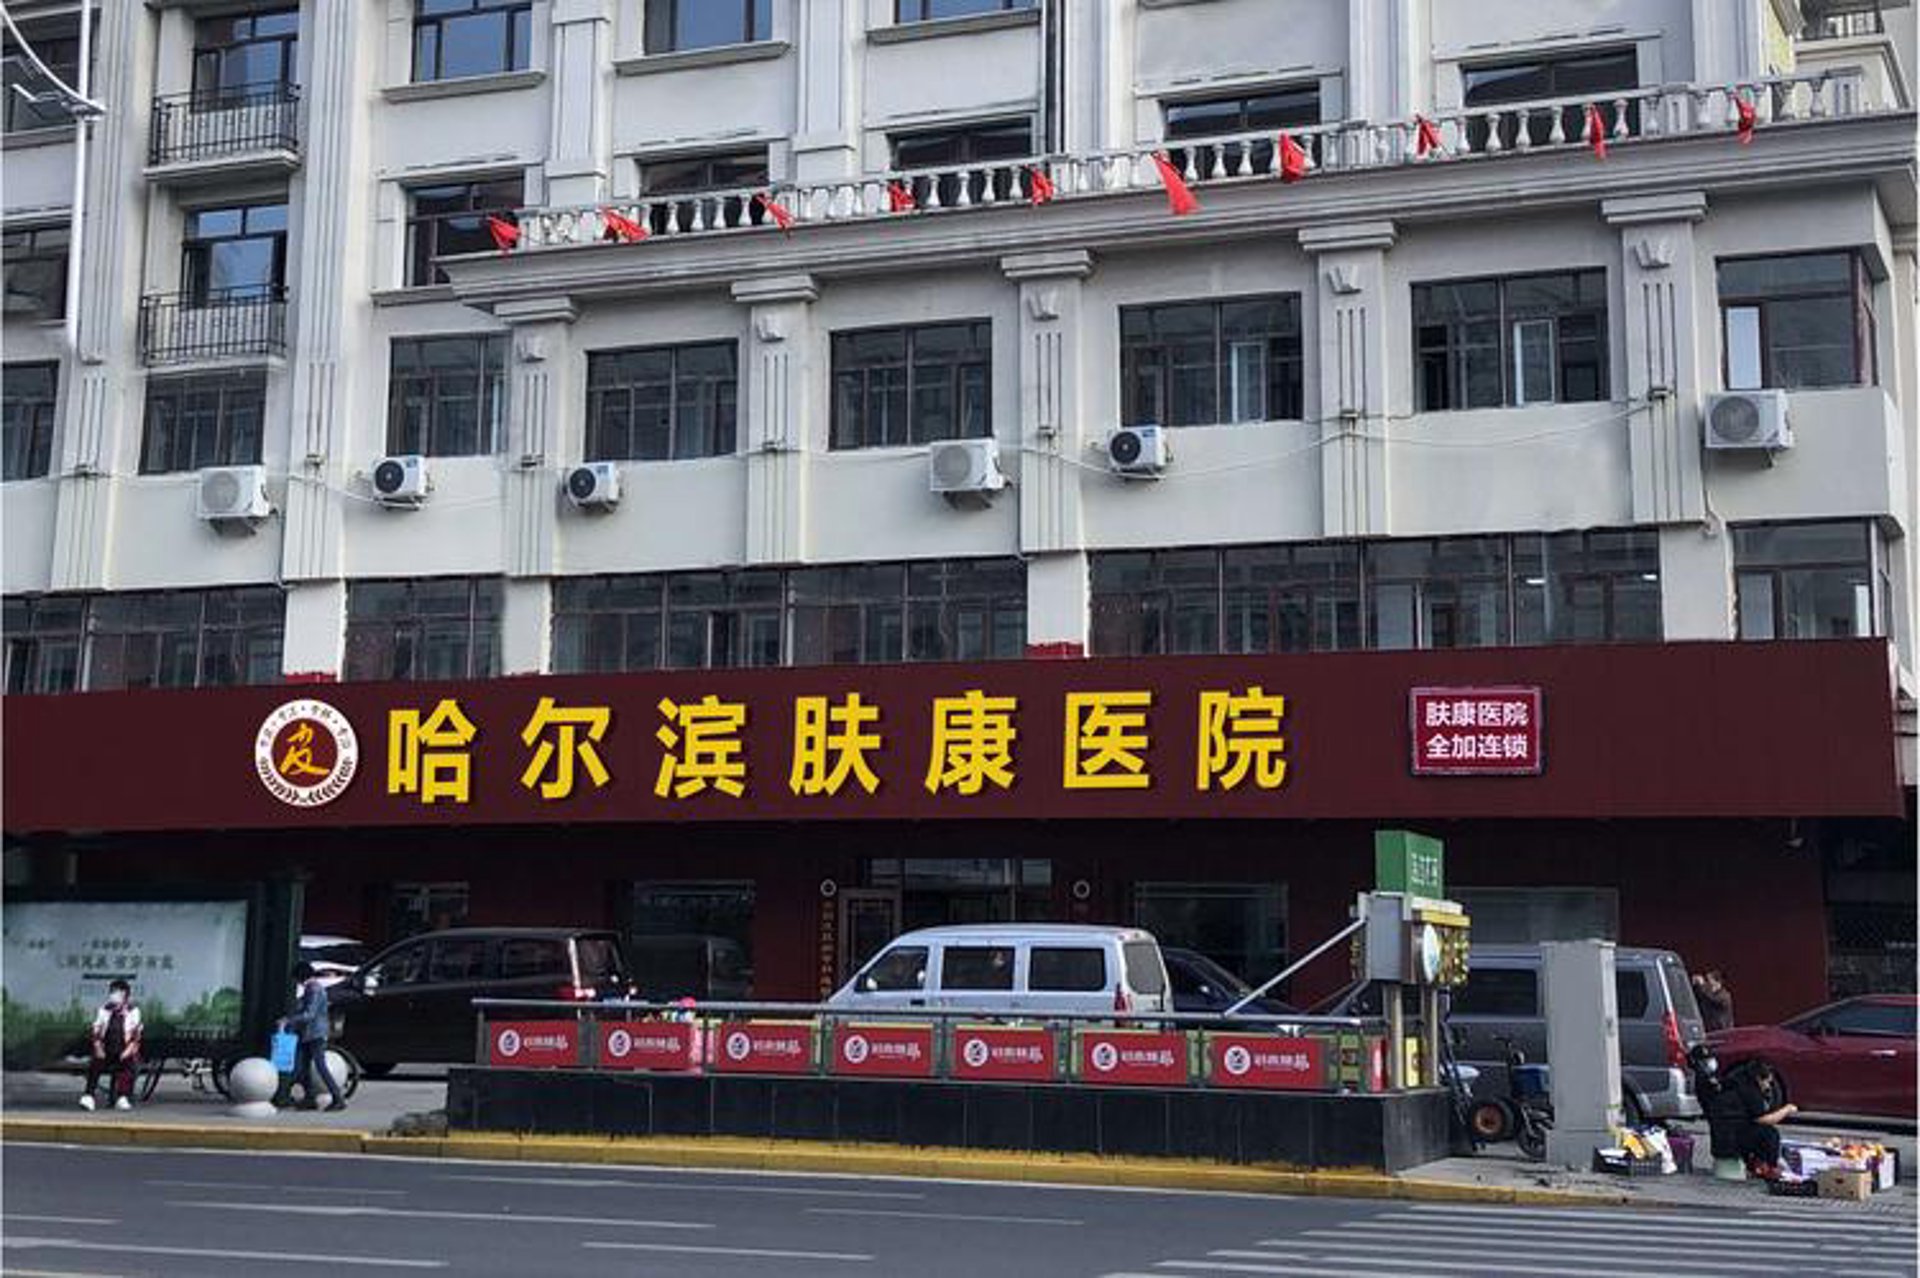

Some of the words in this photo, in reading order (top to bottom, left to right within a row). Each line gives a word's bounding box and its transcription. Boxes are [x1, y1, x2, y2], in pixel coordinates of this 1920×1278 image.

[1425, 700, 1529, 727] 肤康医院
[387, 687, 1288, 804] 哈尔滨肤康医院
[1425, 733, 1529, 759] 全加连锁
